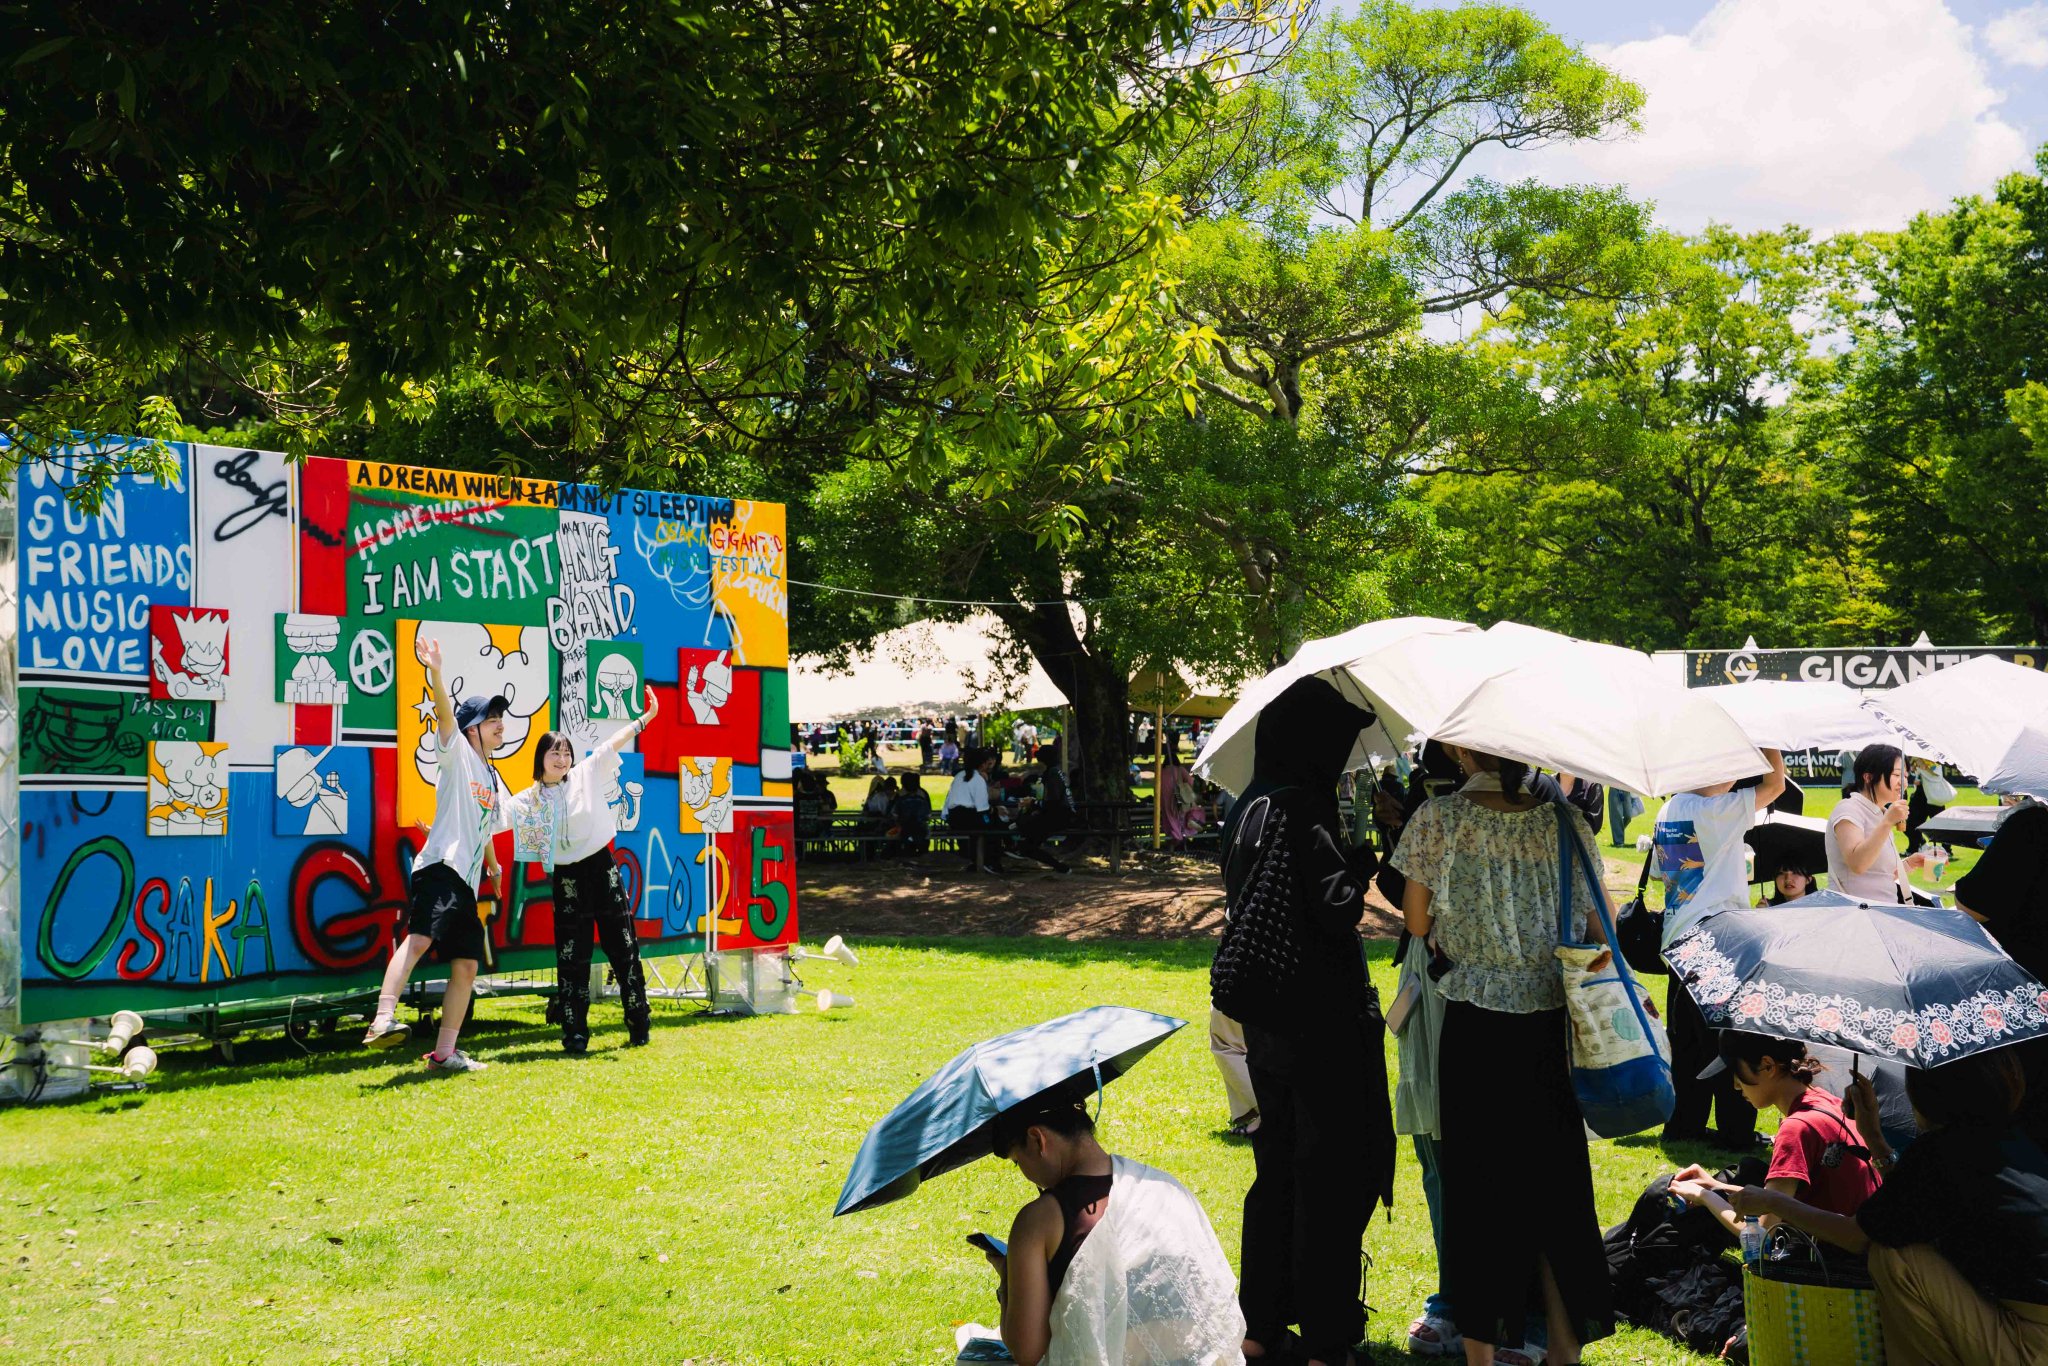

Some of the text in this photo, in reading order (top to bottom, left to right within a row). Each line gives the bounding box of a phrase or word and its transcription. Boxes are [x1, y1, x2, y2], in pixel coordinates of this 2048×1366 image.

[357, 463, 371, 486] A
[379, 465, 458, 497] DREAM
[463, 476, 522, 500] WHEN
[528, 483, 541, 504] I
[544, 481, 579, 510] AM
[583, 488, 629, 515] NOT
[28, 489, 126, 541] SUN
[354, 496, 505, 561] HOMEWORK
[656, 521, 783, 553] OSAKA GIGANTIC
[27, 540, 191, 591] FRIENDS
[363, 572, 385, 615] I
[392, 556, 442, 609] AM
[25, 590, 150, 633] MUSIC
[32, 635, 145, 672] LOVE
[1800, 654, 1976, 685] GIGANT
[131, 697, 177, 719] PASS
[36, 835, 277, 982] OSAKA
